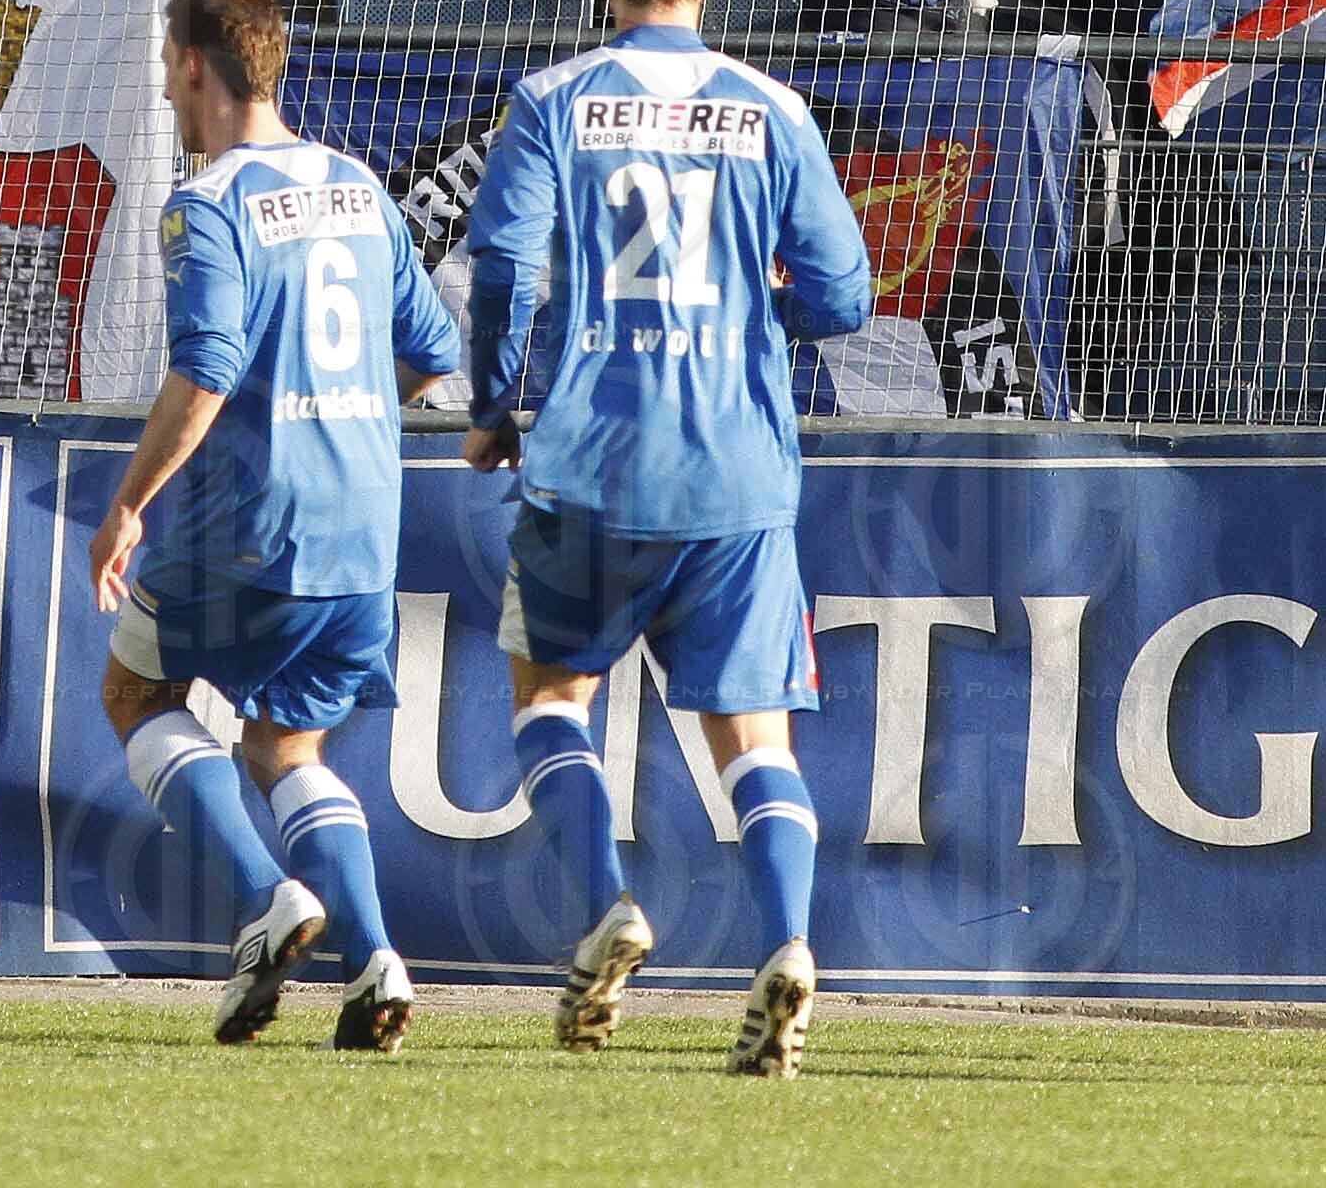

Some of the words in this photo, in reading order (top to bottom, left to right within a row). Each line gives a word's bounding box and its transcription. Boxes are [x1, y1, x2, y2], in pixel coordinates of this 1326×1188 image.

[585, 101, 763, 136] REITERER
[258, 188, 374, 225] REITERER
[603, 162, 722, 307] 21
[306, 239, 362, 372] 6
